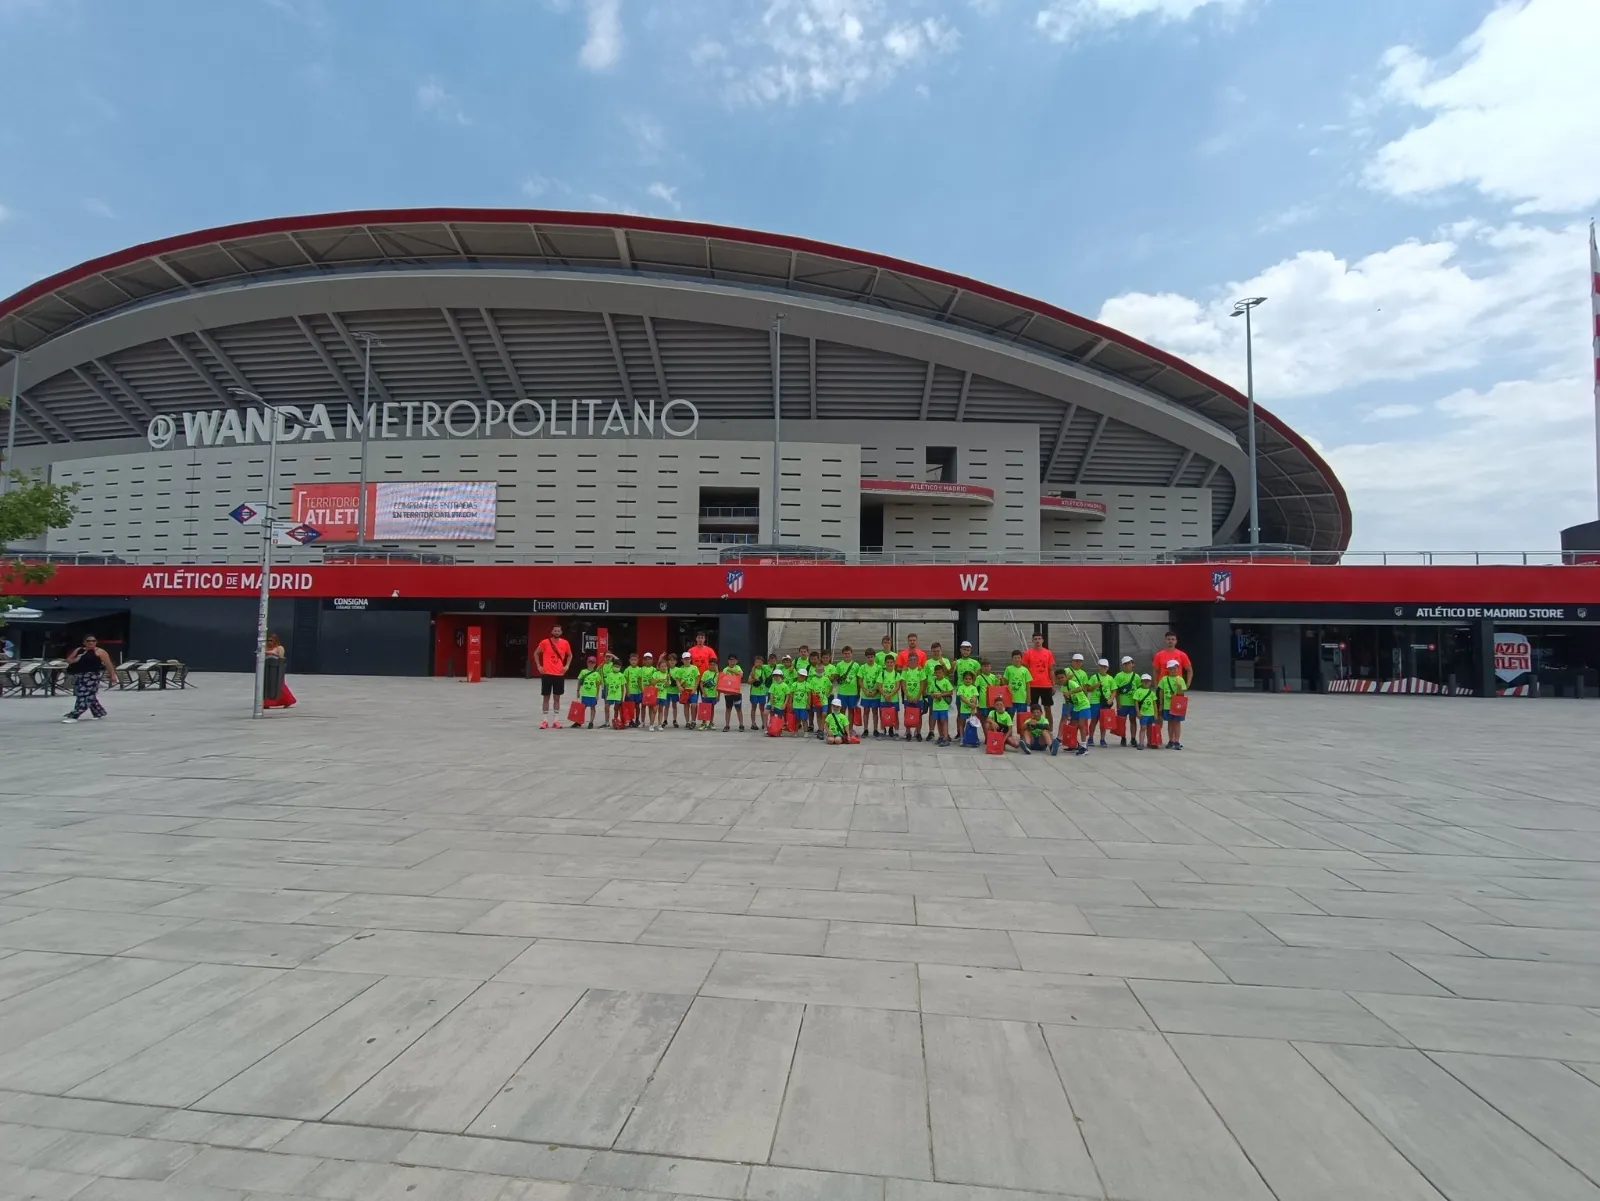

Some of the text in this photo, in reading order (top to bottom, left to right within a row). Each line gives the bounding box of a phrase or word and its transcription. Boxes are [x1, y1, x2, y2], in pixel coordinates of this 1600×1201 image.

[182, 399, 699, 447] WANDA METROPOLITANO
[305, 496, 360, 508] TERRITORIO
[304, 508, 359, 525] ATLETI
[142, 569, 223, 589] ATLÉTICO
[241, 572, 313, 590] MADRID
[959, 573, 989, 591] W2
[333, 597, 369, 606] CONSIGNA
[1416, 606, 1564, 618] ATLÉTICO DE MADRID STORE
